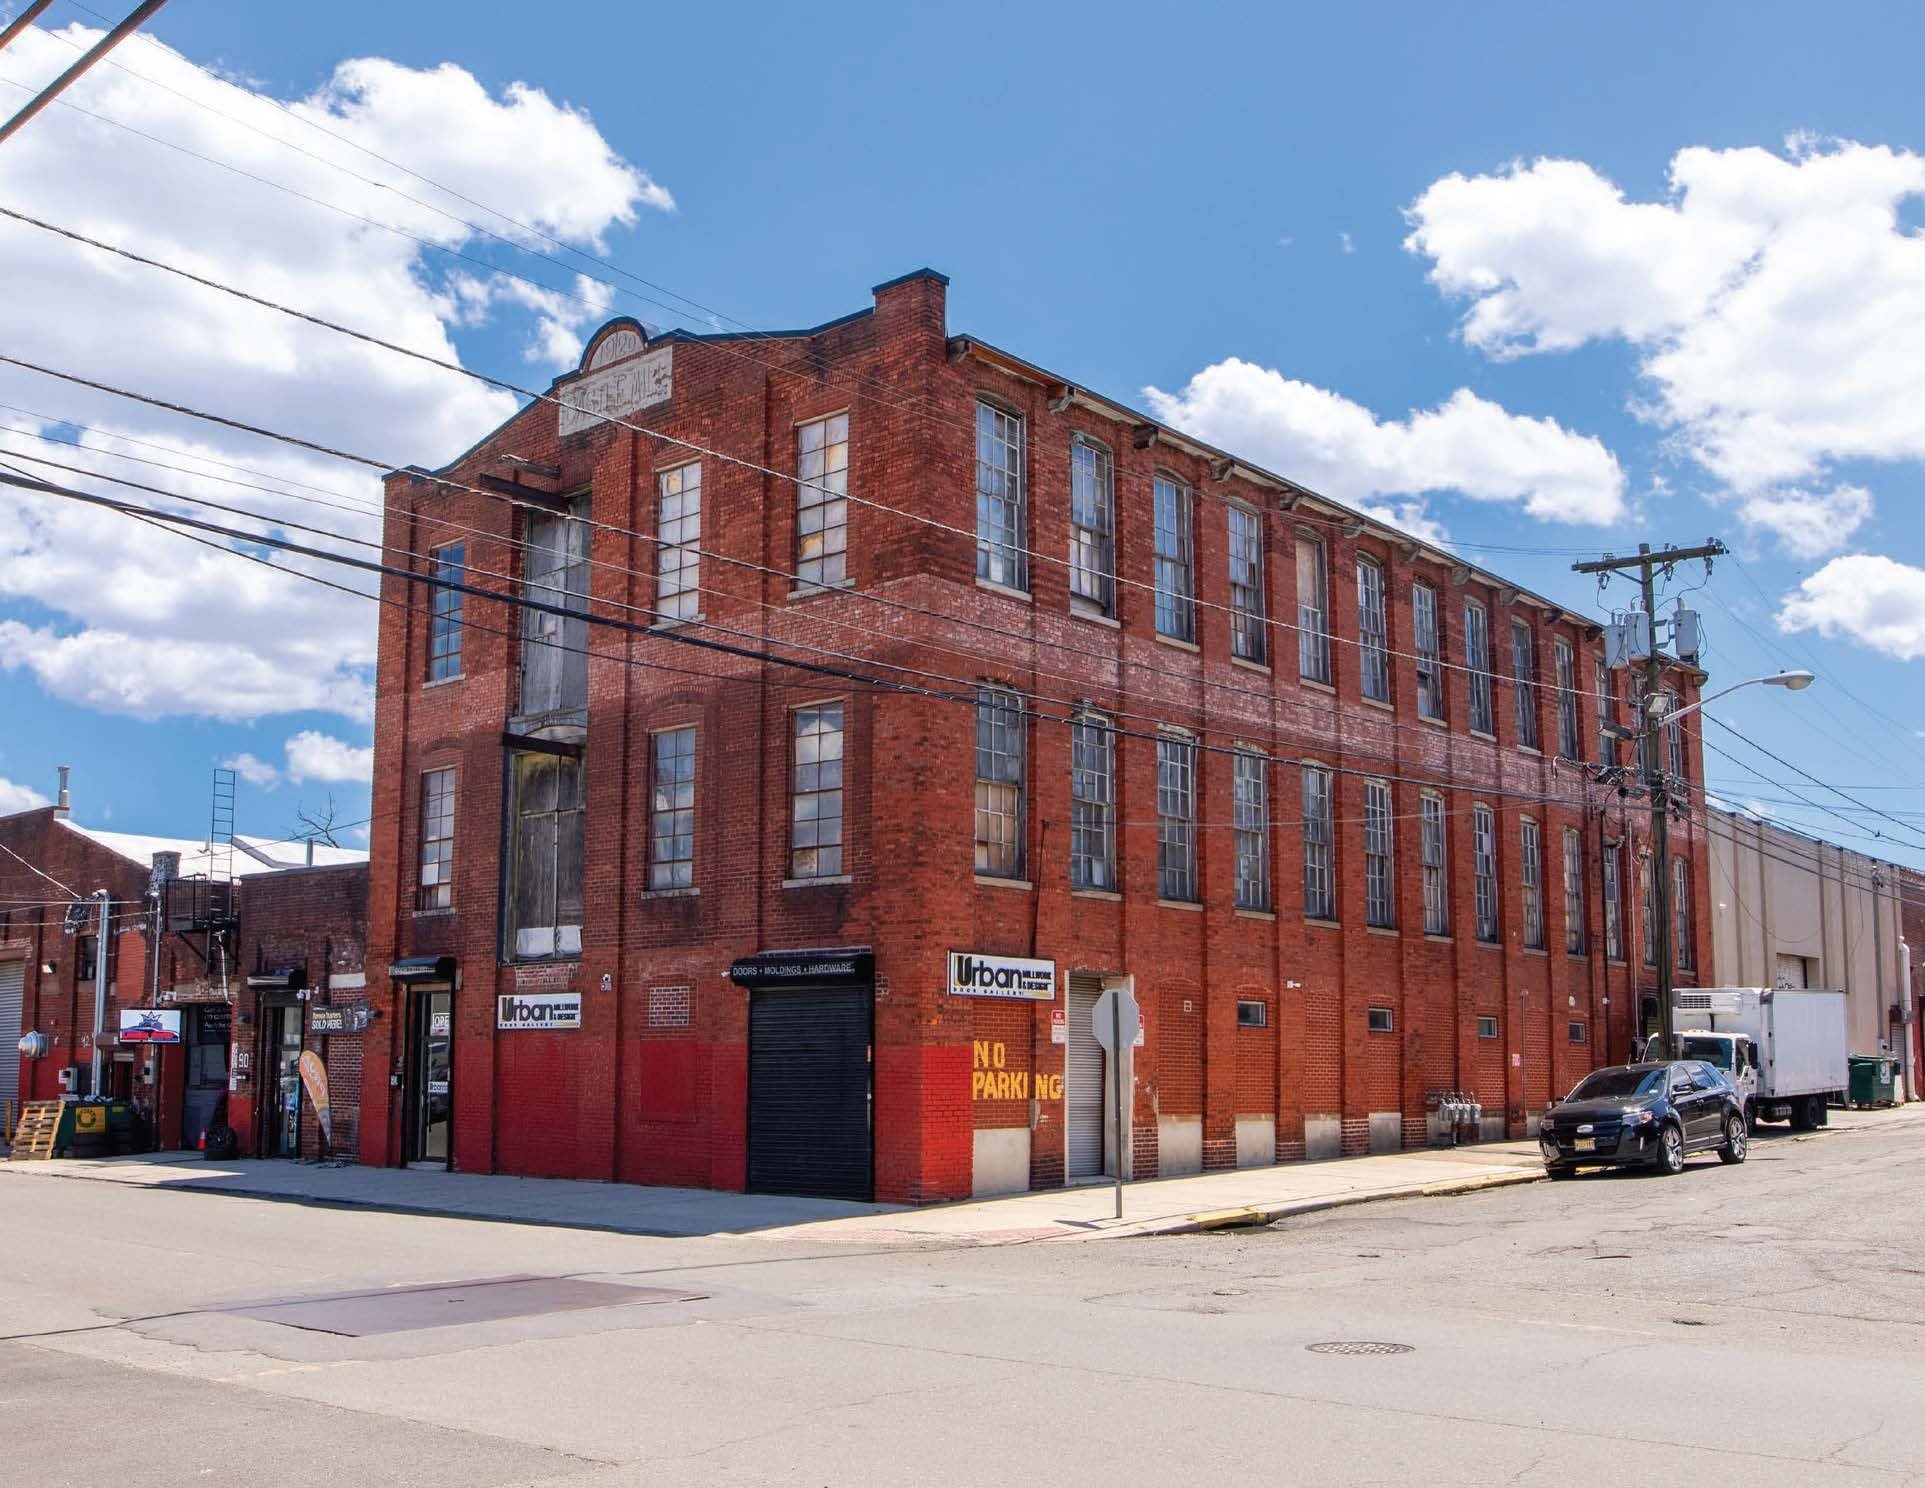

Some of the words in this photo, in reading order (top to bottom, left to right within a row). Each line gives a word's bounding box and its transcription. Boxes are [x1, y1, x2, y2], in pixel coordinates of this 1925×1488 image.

[732, 966, 758, 976] DOORS
[764, 964, 801, 976] MOLDINGS
[808, 962, 852, 974] HARDWARE
[954, 955, 1023, 989] Urban
[434, 1014, 450, 1028] OPE
[501, 996, 554, 1022] Urban
[238, 1053, 249, 1068] 90
[973, 1040, 1006, 1069] NO
[972, 1071, 1062, 1101] PARKING
